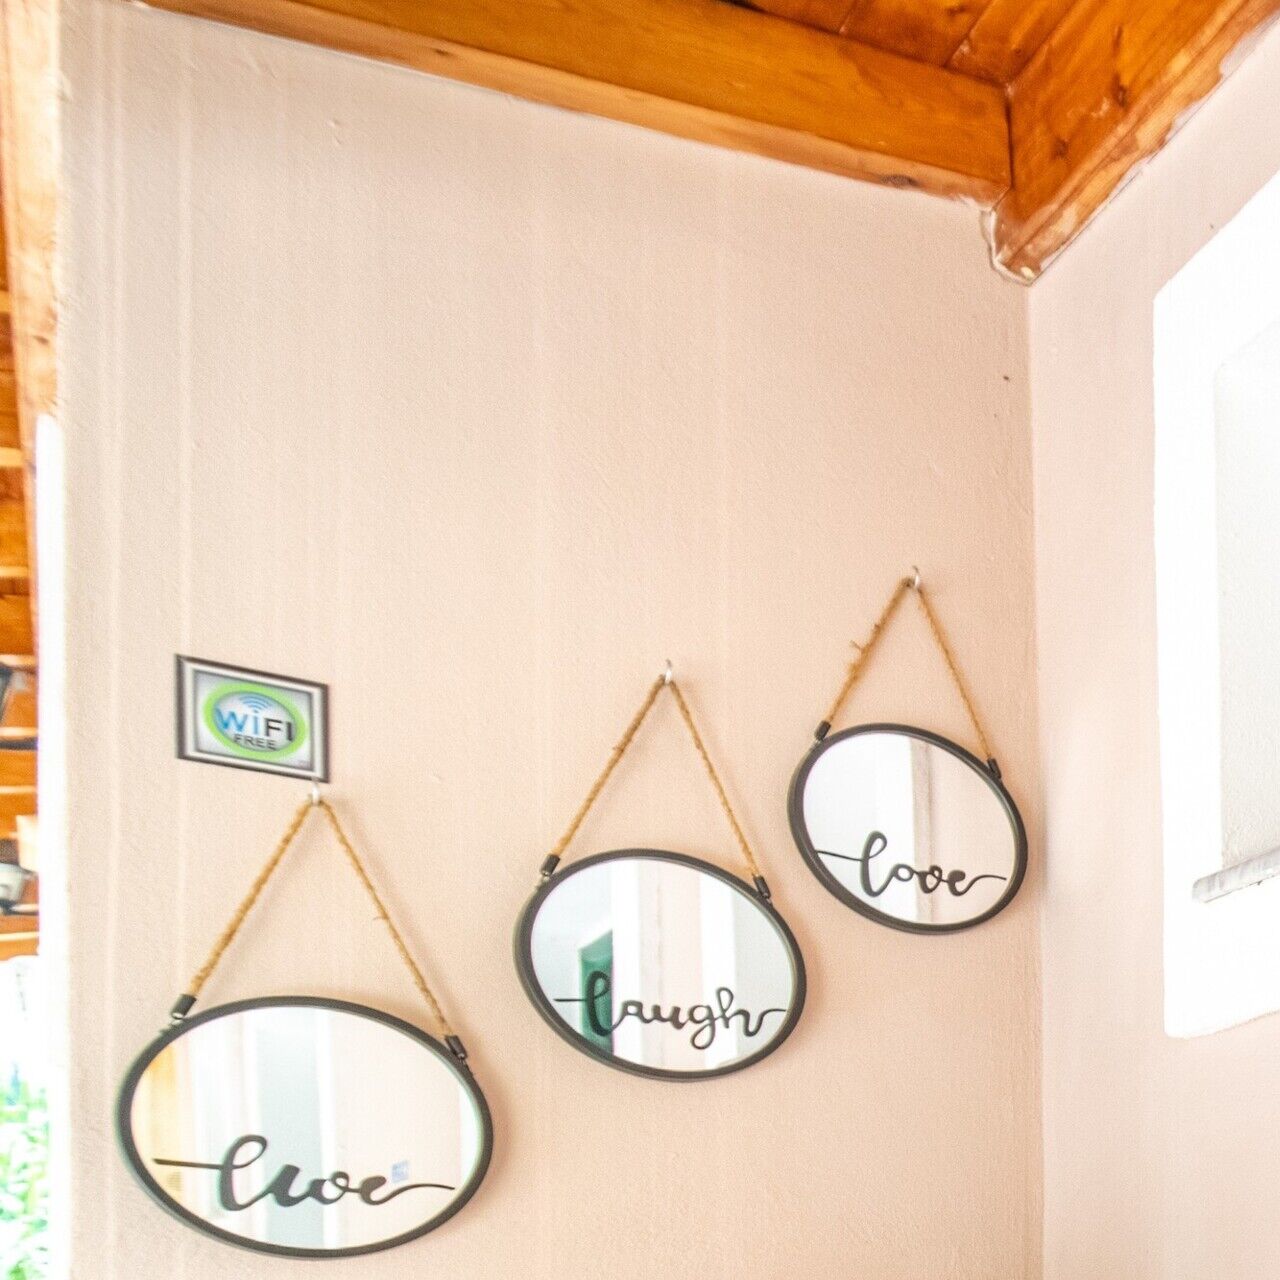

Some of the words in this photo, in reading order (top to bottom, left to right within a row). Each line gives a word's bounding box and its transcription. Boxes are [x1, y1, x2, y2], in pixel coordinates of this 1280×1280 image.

[234, 734, 277, 751] FREE
[816, 831, 1007, 898] love
[554, 971, 786, 1050] laugh
